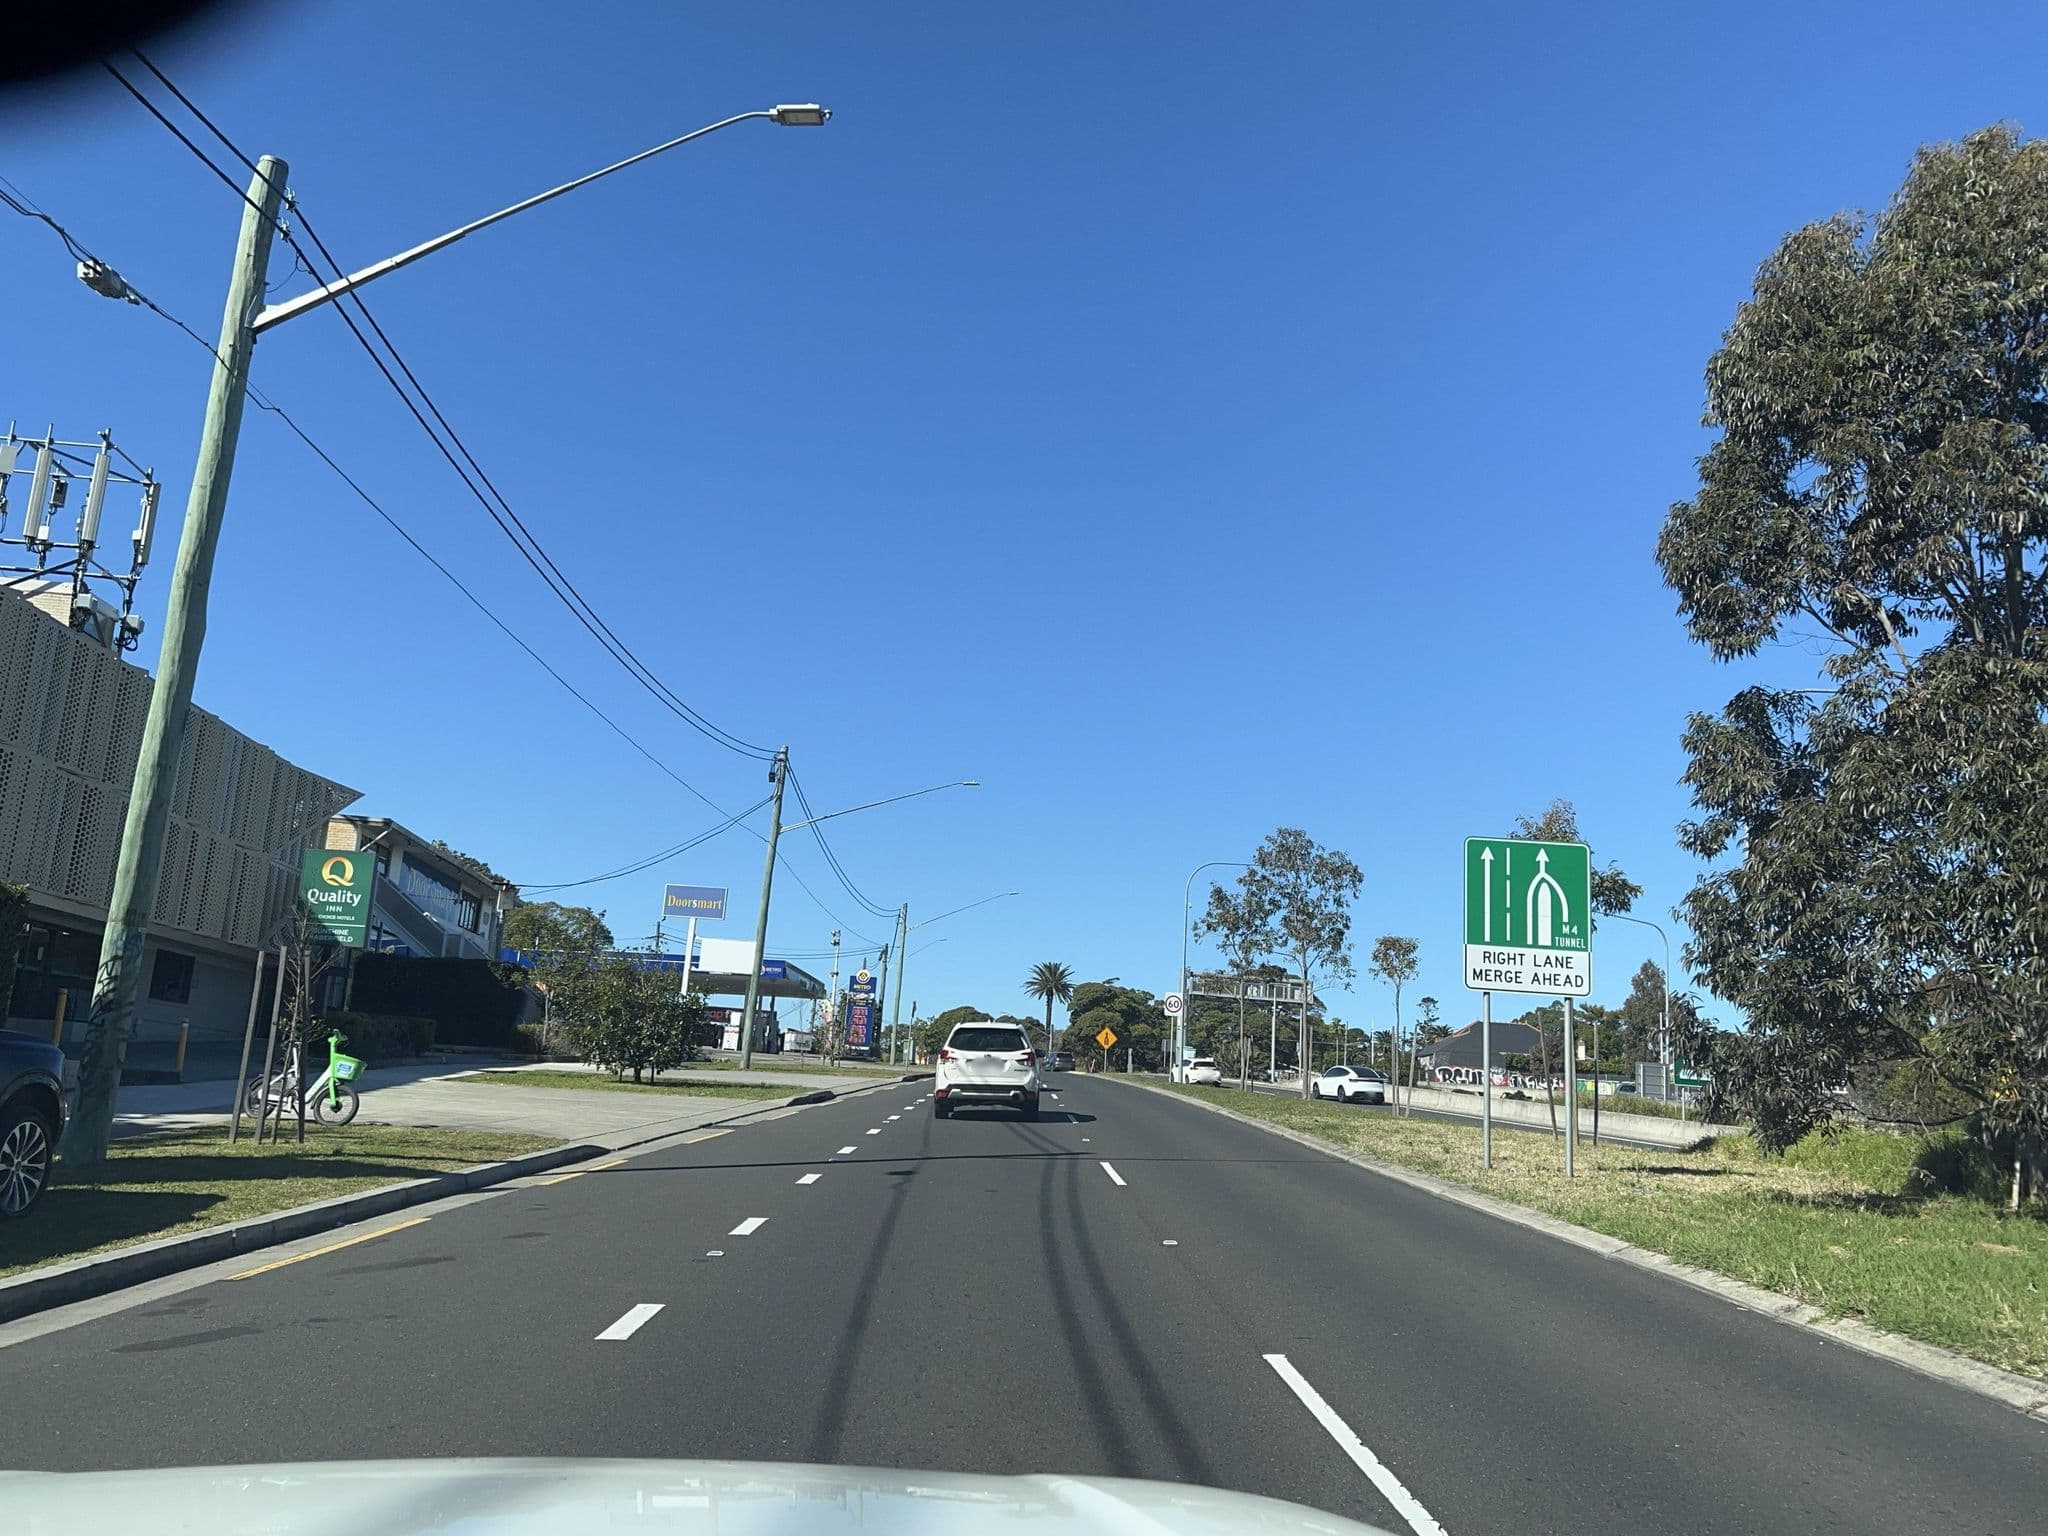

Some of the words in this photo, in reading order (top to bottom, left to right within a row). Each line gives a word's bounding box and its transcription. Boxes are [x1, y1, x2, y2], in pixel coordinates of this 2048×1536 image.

[322, 856, 354, 887] Q
[307, 888, 362, 907] Quality
[667, 894, 722, 910] Doorsmart
[326, 905, 343, 913] INN
[1555, 936, 1586, 949] TUNNEL
[1482, 951, 1526, 966] RIGHT
[1533, 954, 1574, 970] LANE
[1472, 968, 1523, 984] MERGE
[1531, 972, 1584, 988] AHEAD
[1168, 1000, 1180, 1009] 60
